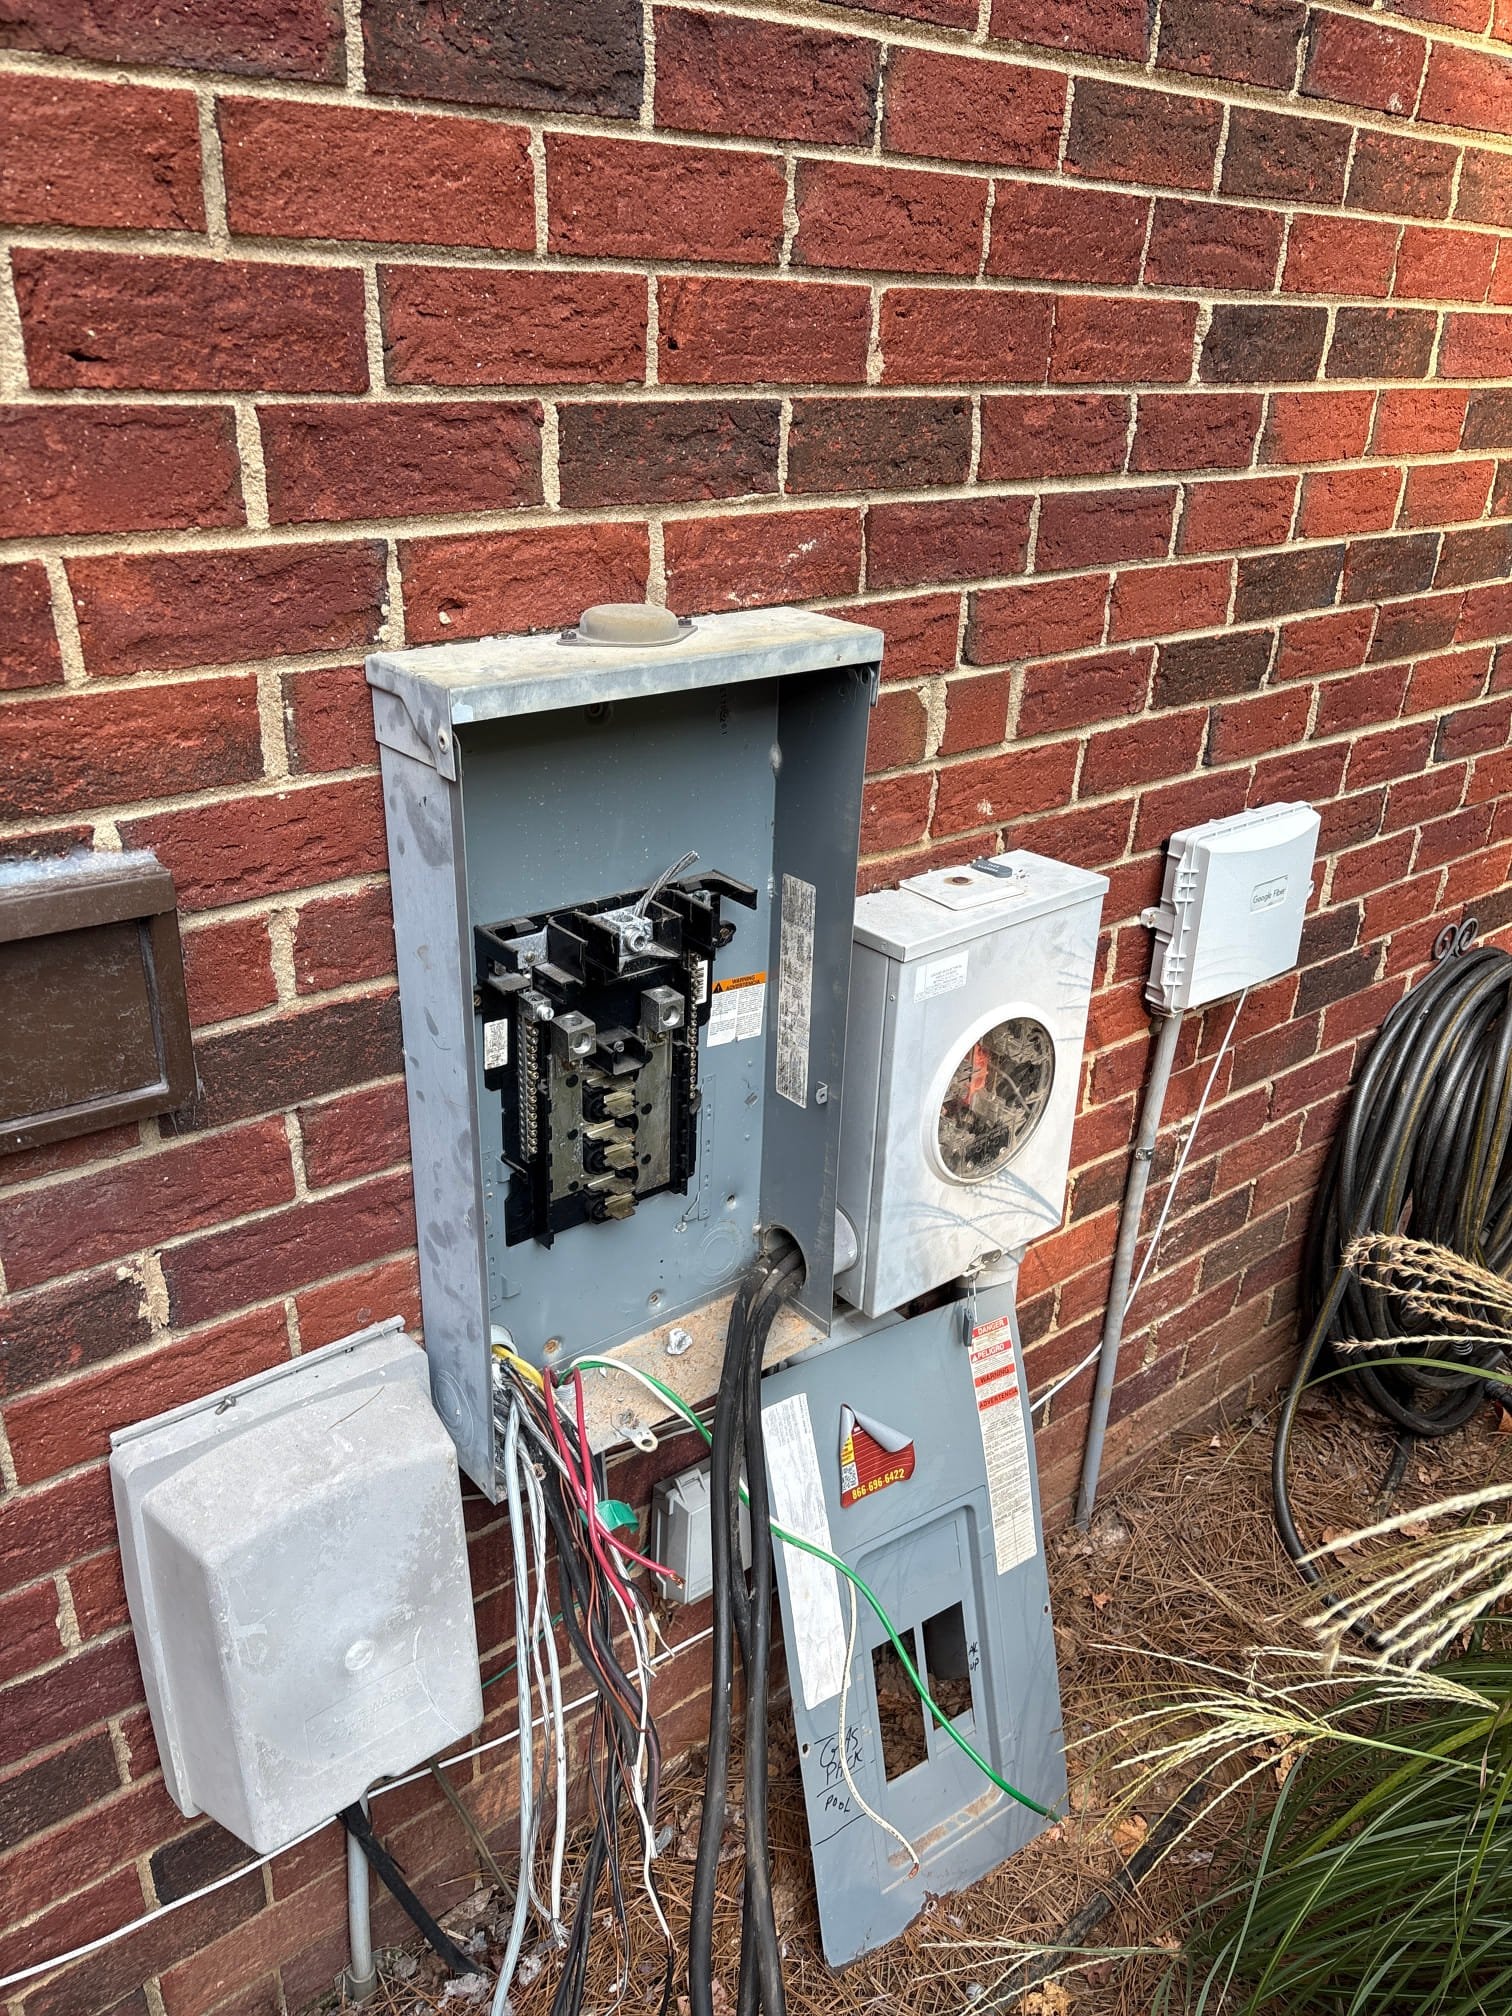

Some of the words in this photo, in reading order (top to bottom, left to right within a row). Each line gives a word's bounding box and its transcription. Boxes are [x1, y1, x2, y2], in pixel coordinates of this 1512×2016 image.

[1253, 892, 1272, 903] Google
[1273, 888, 1286, 897] Fiber
[731, 974, 757, 985] WARNING
[977, 1319, 1005, 1336] DANGER
[977, 1343, 1005, 1360] PELIGRO
[980, 1366, 1010, 1385] WARNING
[979, 1384, 1018, 1410] ADVERTENCIA
[824, 1794, 850, 1812] POOL
